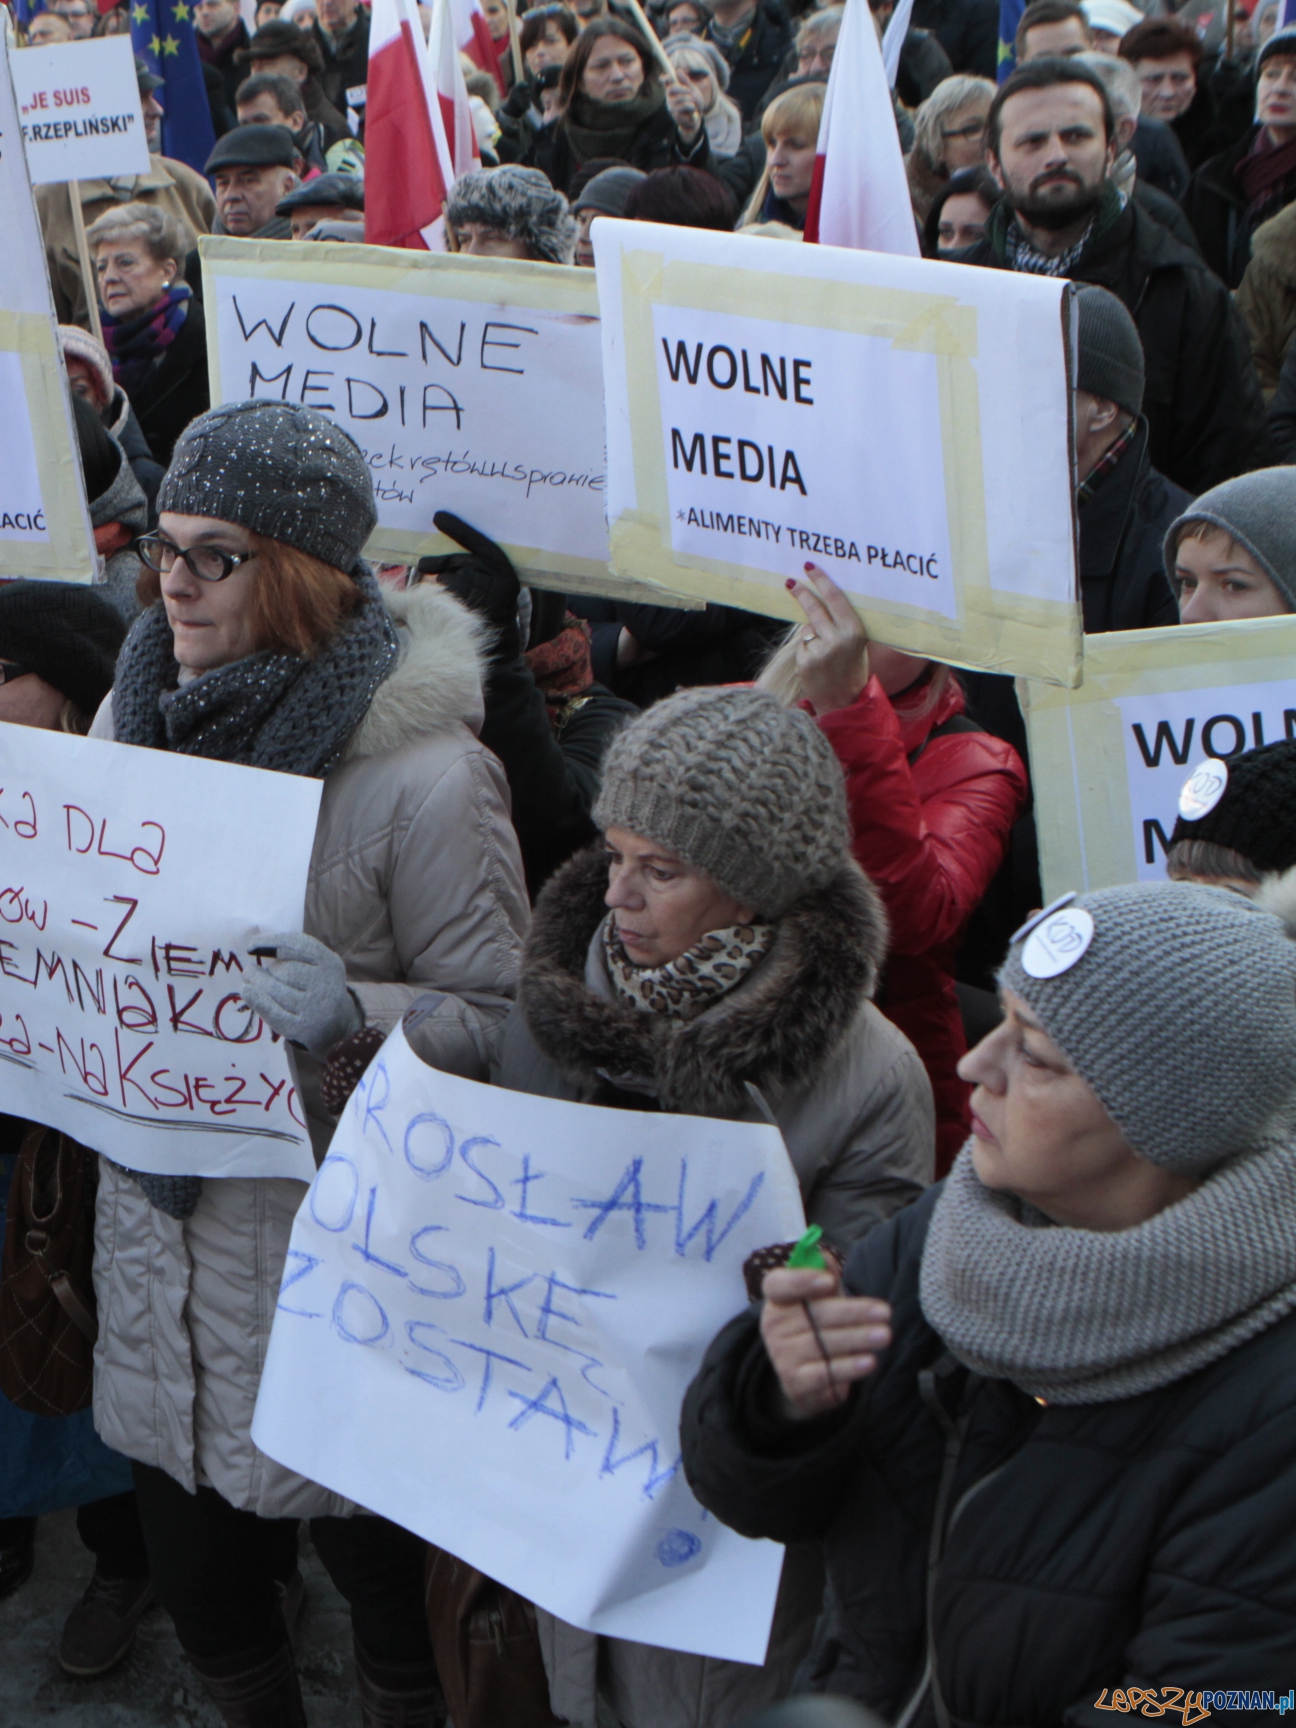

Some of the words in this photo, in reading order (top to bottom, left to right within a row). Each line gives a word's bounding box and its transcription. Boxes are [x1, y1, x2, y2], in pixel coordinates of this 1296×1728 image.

[53, 87, 91, 107] SUIS
[233, 294, 538, 375] WOLNE
[250, 361, 464, 430] MEDIA
[662, 337, 814, 405] WOLNE
[372, 480, 414, 503] tów
[671, 427, 807, 496] MEDIA
[787, 528, 860, 562] TRZEBA
[867, 545, 939, 579] PŁACIĆ
[356, 1057, 766, 1263] ROSŁAW
[309, 1152, 619, 1397] OLSKĘ
